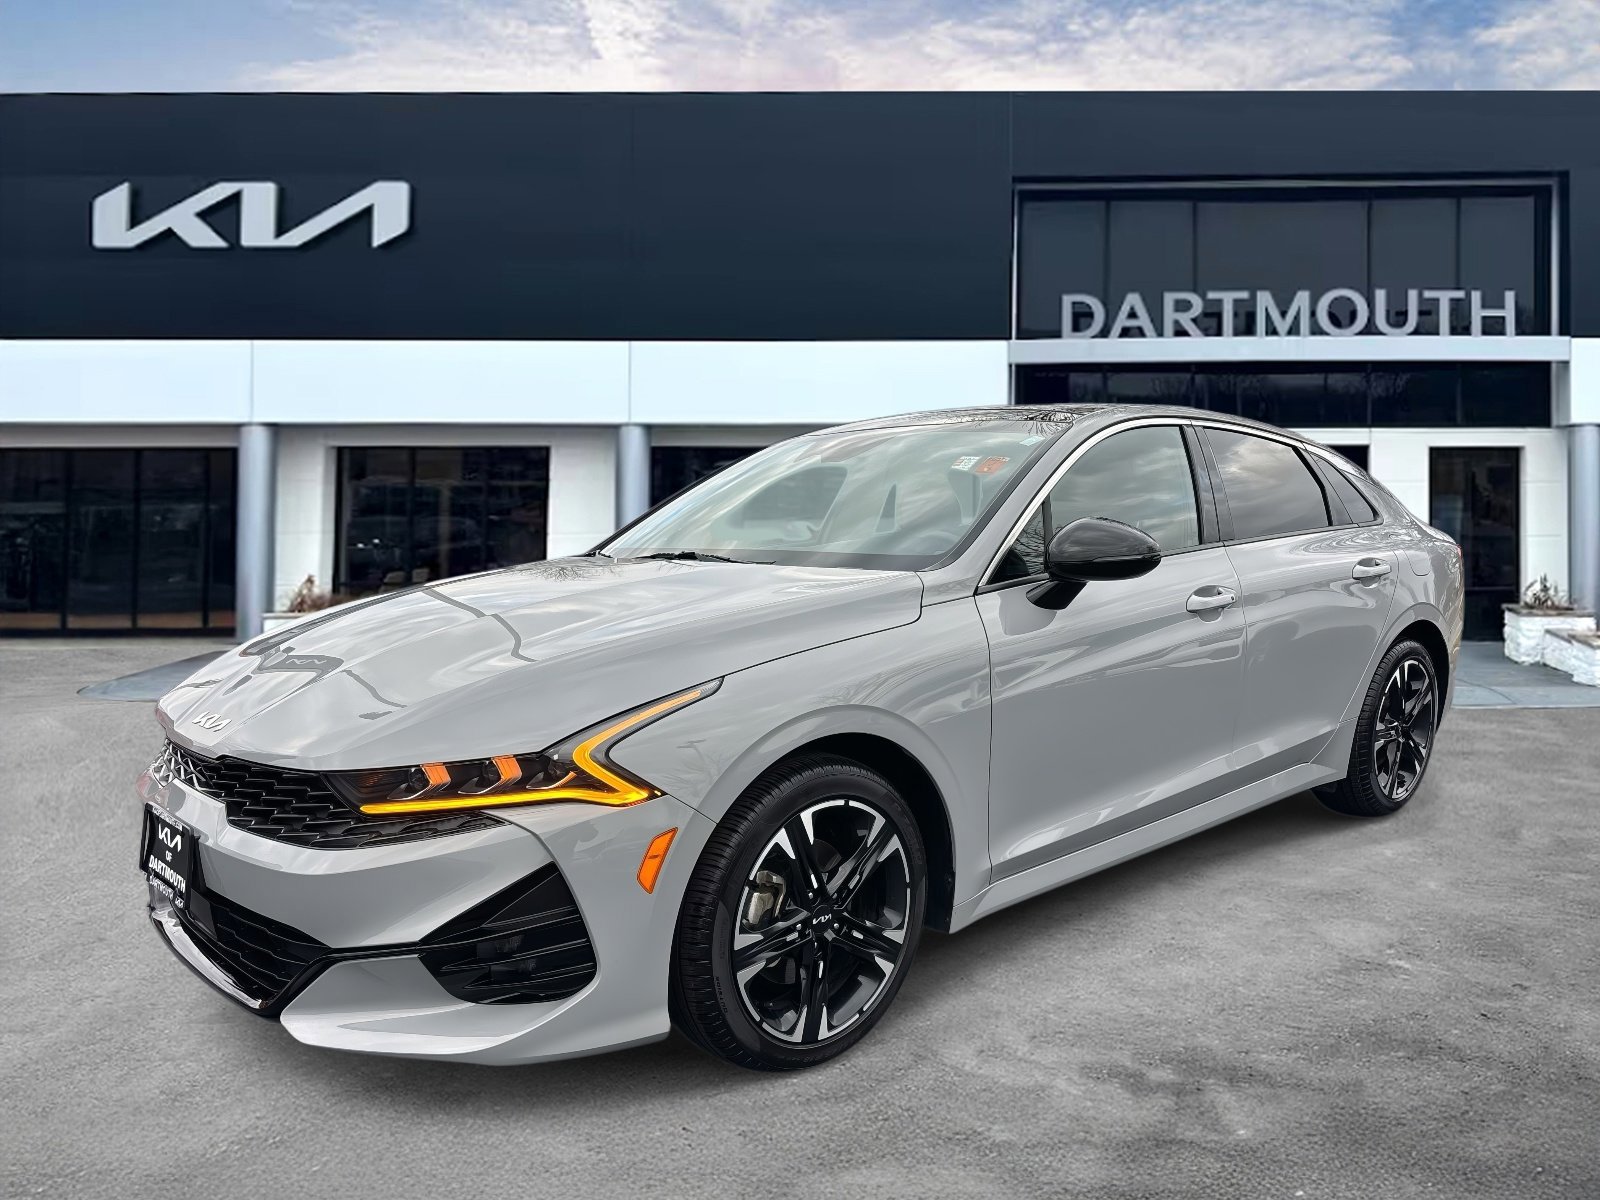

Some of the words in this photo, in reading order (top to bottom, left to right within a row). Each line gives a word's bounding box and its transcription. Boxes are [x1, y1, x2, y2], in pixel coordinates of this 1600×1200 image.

[1060, 288, 1517, 339] DARTMOUTH
[148, 854, 186, 893] DARTMOUTH
[165, 850, 173, 862] OF
